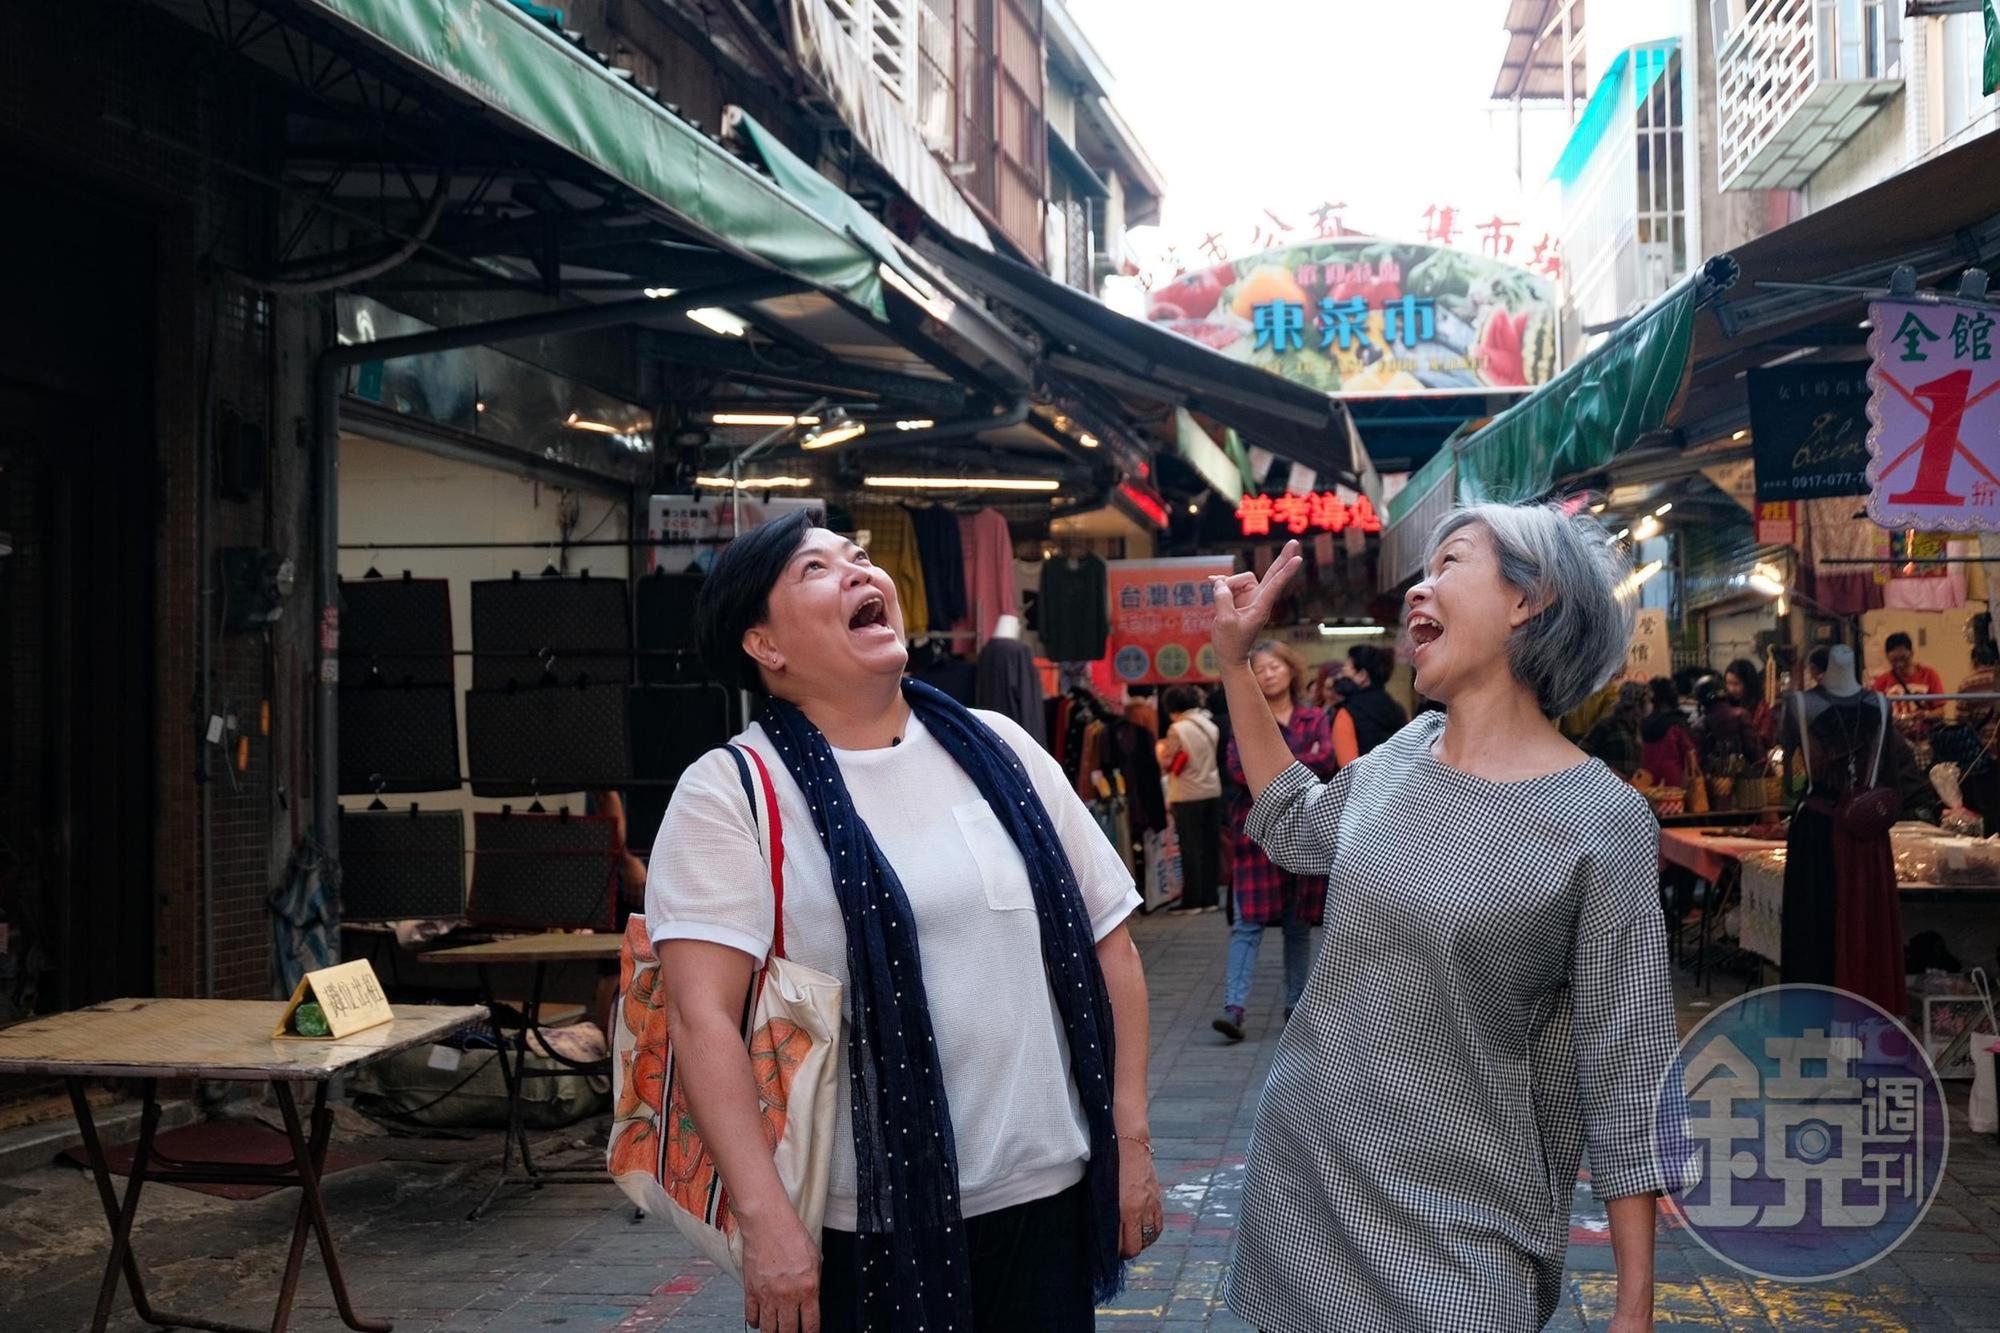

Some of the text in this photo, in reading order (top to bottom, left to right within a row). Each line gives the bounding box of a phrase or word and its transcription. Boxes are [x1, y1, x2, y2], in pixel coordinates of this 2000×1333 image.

[1252, 294, 1437, 352] 東菜市
[1891, 312, 1997, 362] 全館
[1888, 369, 1973, 506] 1
